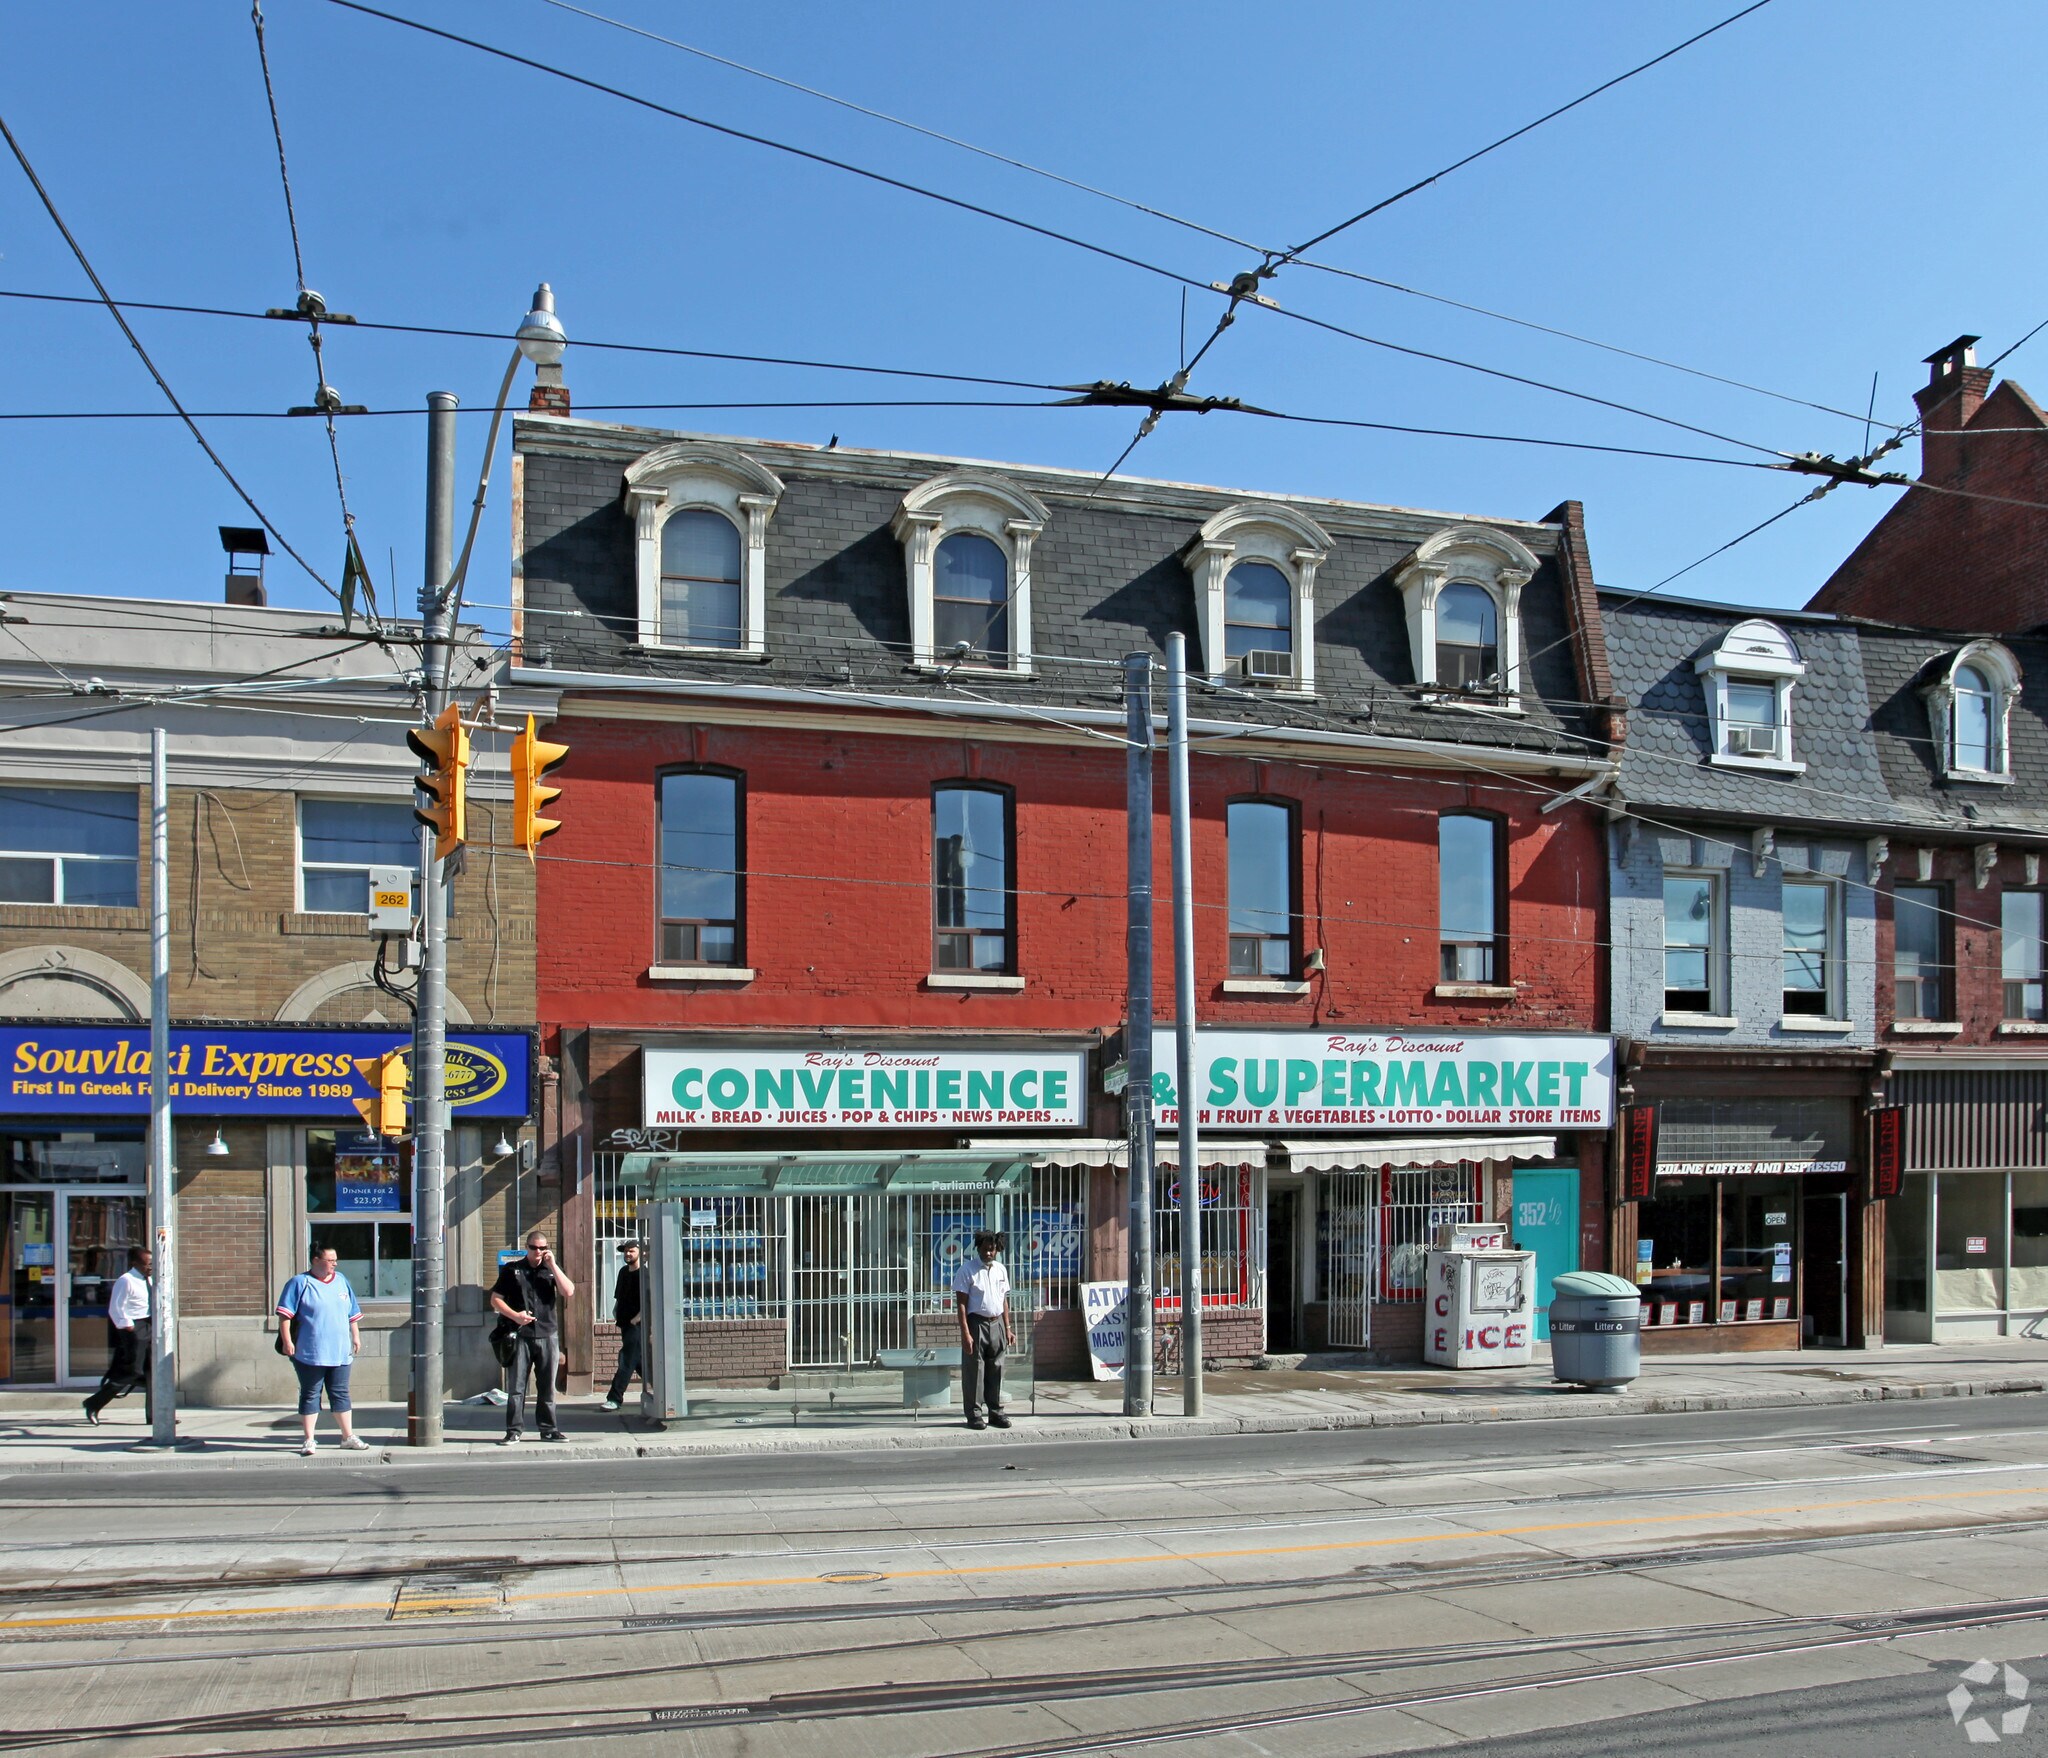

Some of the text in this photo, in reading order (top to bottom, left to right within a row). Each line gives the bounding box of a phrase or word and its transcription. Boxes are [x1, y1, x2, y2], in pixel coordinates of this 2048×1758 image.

[380, 894, 404, 905] 262
[1327, 1035, 1464, 1056] Ray's Discount
[201, 1045, 352, 1083] Express
[804, 1052, 940, 1070] Ray's Discount
[12, 1081, 53, 1095] First
[58, 1081, 76, 1095] In
[81, 1082, 133, 1095] Greek
[184, 1083, 253, 1099] Delivery
[257, 1084, 302, 1097] Since
[308, 1084, 353, 1097] 1989
[671, 1067, 1068, 1110] CONVENIENCE
[1152, 1071, 1178, 1107] &
[1206, 1057, 1589, 1107] SUPERMARKET
[656, 1111, 697, 1123] MILK
[711, 1111, 763, 1123] BREAD
[777, 1110, 828, 1123] JUICES
[841, 1111, 873, 1123] POP
[878, 1111, 890, 1123] &
[894, 1110, 938, 1123] CHIPS
[952, 1110, 993, 1123] NEWS
[1161, 1109, 1601, 1124] FRH FRUIT & VEGETABLES LOTTO DOLLAR STORE ITEMS
[1632, 1108, 1648, 1197] REDLINE
[1880, 1110, 1895, 1195] REDLINE
[1656, 1161, 1847, 1175] EDLINE COFFEE AND ESPRESSO
[932, 1179, 1011, 1191] Parliament St
[353, 1196, 382, 1205] $23.95
[1519, 1202, 1547, 1226] 352
[1765, 1216, 1786, 1225] OPEN
[1471, 1235, 1501, 1248] ICE
[1558, 1322, 1576, 1331] Litter
[1594, 1321, 1615, 1331] Litter
[1465, 1323, 1527, 1350] ICE
